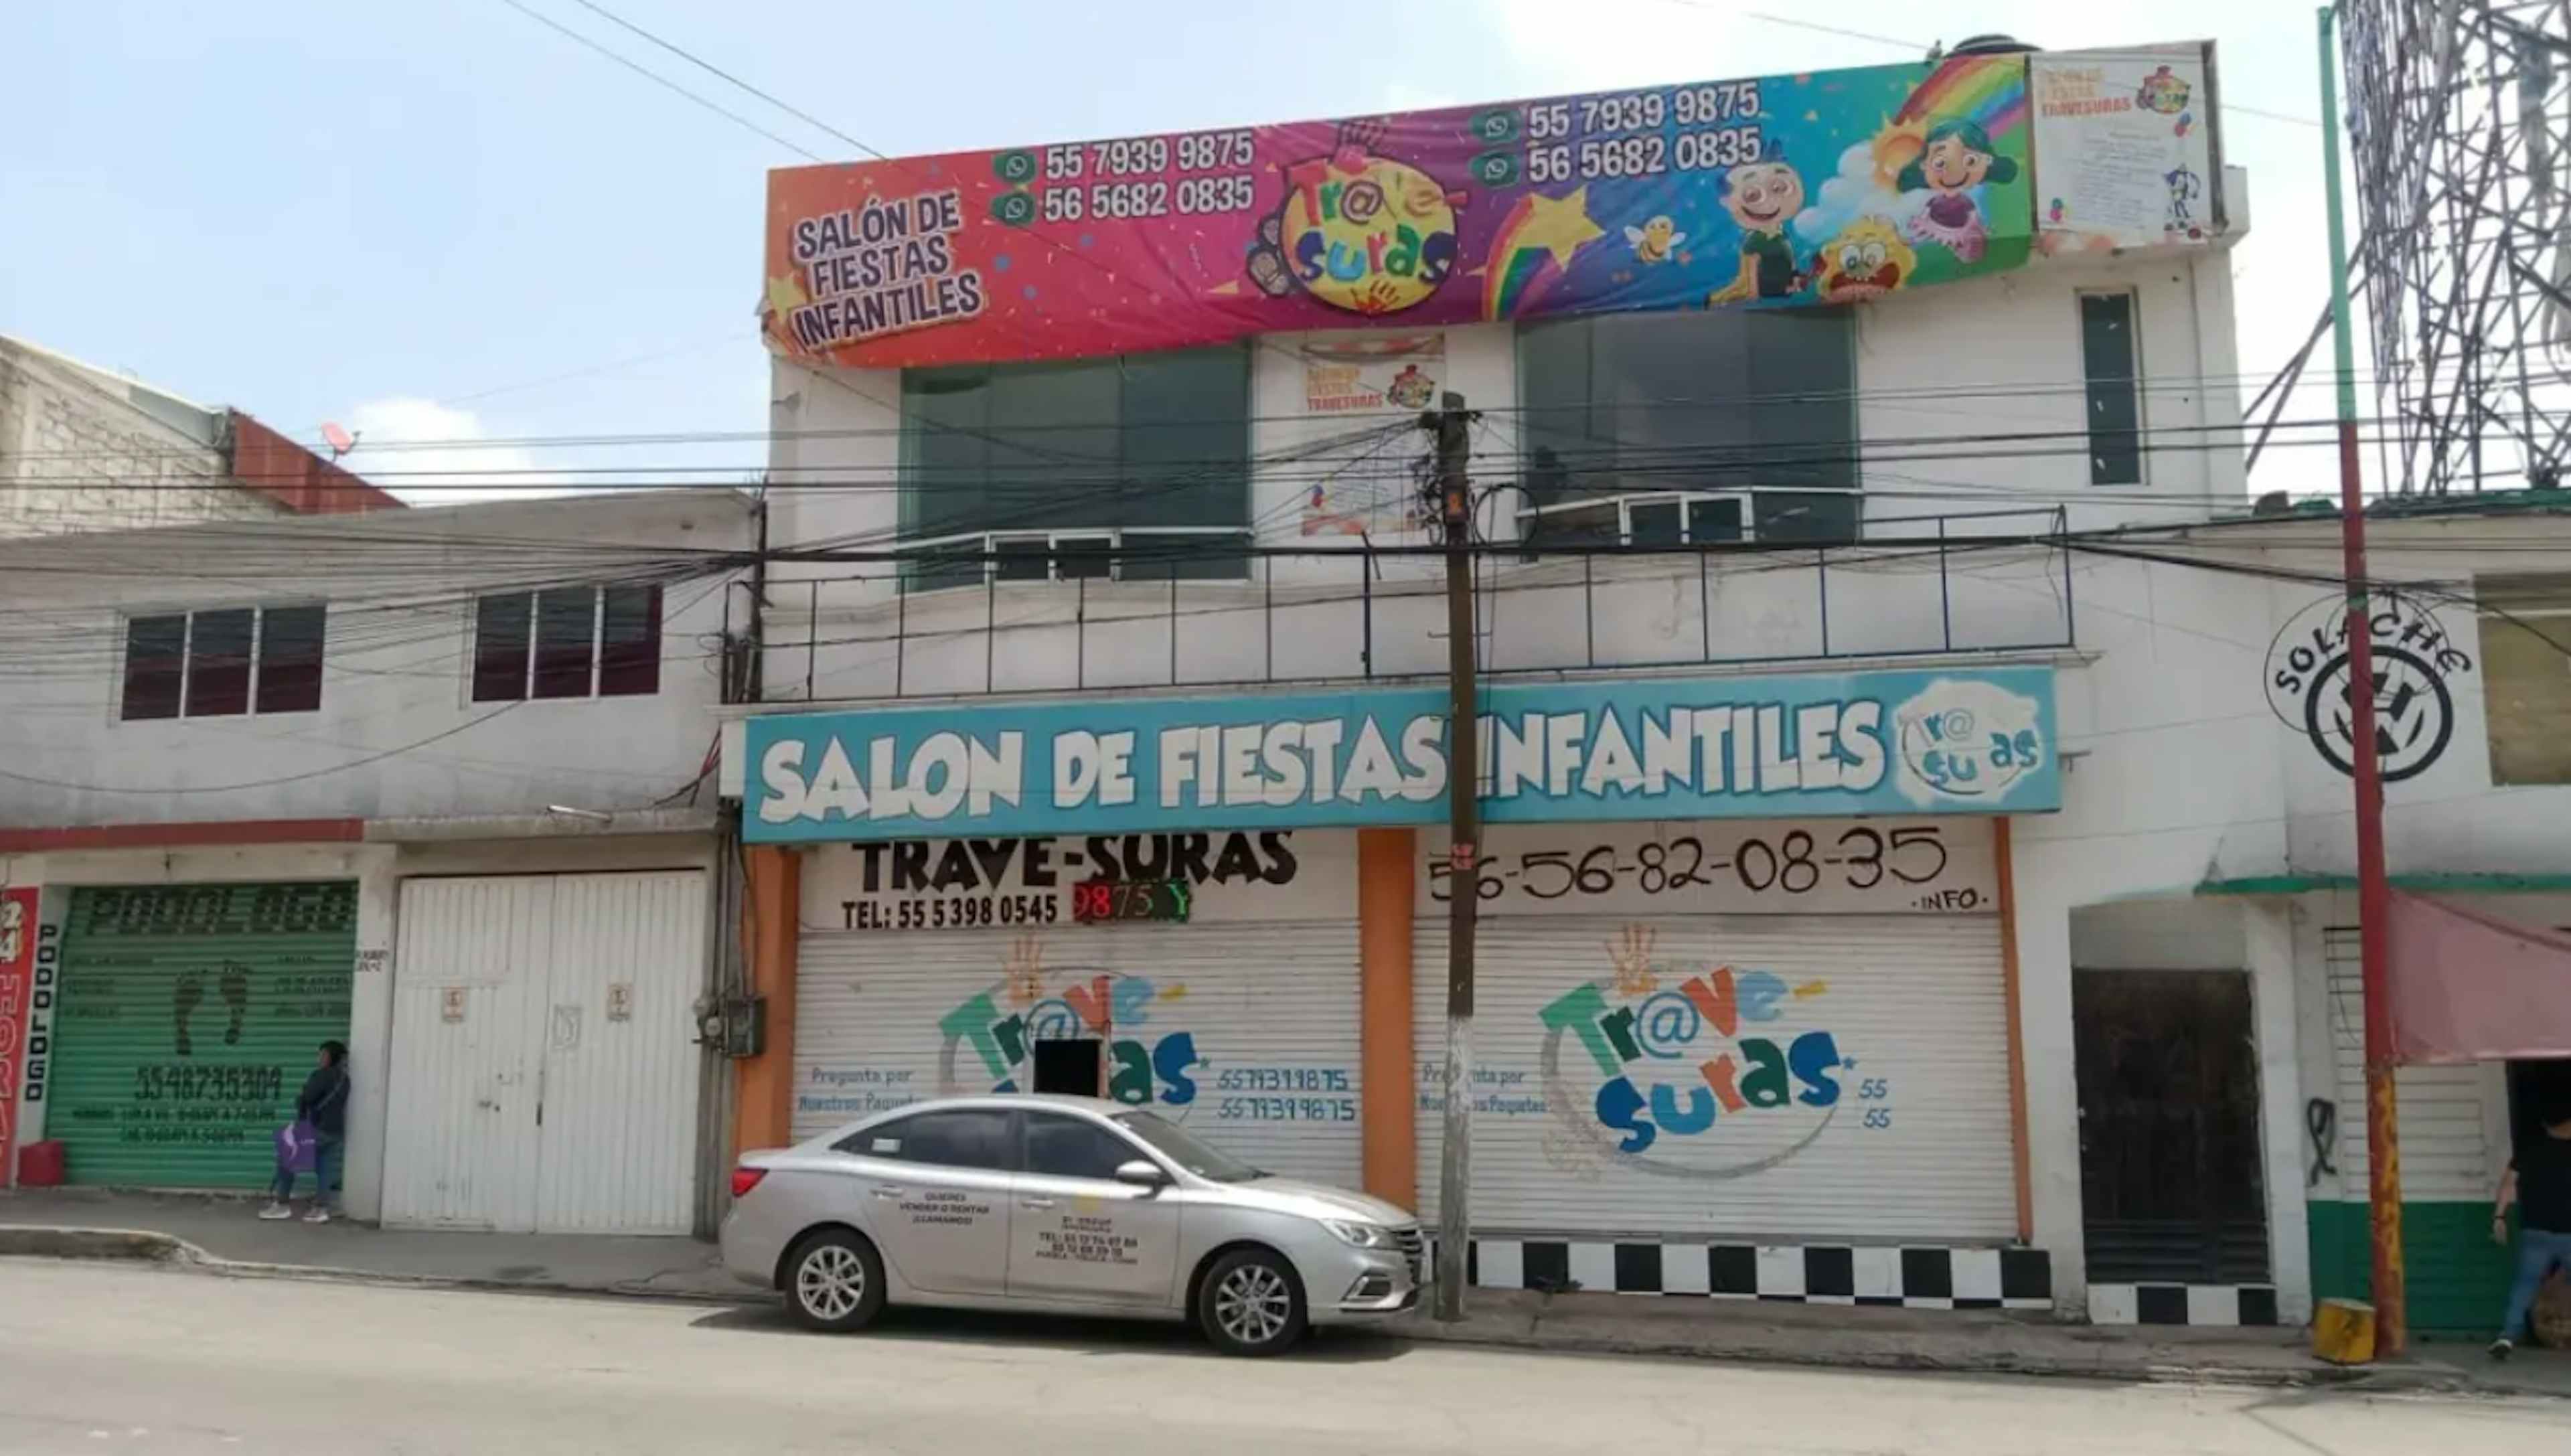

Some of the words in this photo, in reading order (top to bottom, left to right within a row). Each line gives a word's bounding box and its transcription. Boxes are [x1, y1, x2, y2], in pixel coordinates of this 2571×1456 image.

[1529, 104, 1569, 138] 55
[1581, 94, 1664, 133] 7939
[1675, 82, 1760, 125] 9875
[1046, 145, 1083, 179] 55
[1094, 139, 1168, 175] 7939
[1178, 132, 1253, 170] 9875
[1529, 146, 1571, 183] 56
[1580, 137, 1666, 179] 5682
[1675, 127, 1762, 171] 0835
[1045, 187, 1083, 221] 56
[1092, 181, 1168, 218] 5682
[1176, 175, 1253, 214] 0835
[796, 197, 909, 260] SALÓN
[918, 193, 960, 232] DE
[811, 236, 949, 295] FIESTAS
[793, 272, 982, 351] INFANTILES
[759, 730, 1023, 823] SALON
[1052, 730, 1136, 808] DE
[1160, 714, 1450, 807] FIESTAS
[1476, 700, 1887, 799] INFANTILES
[852, 831, 1297, 893] TRAVE-SURAS
[842, 902, 891, 929] TEL:
[1000, 894, 1058, 923] 0545
[24, 924, 58, 1101] PODOLOGO
[886, 1070, 915, 1087] por
[1500, 1071, 1525, 1087] por
[1595, 1031, 1841, 1153] suras
[1858, 1078, 1888, 1099] 55
[1863, 1108, 1891, 1129] 55
